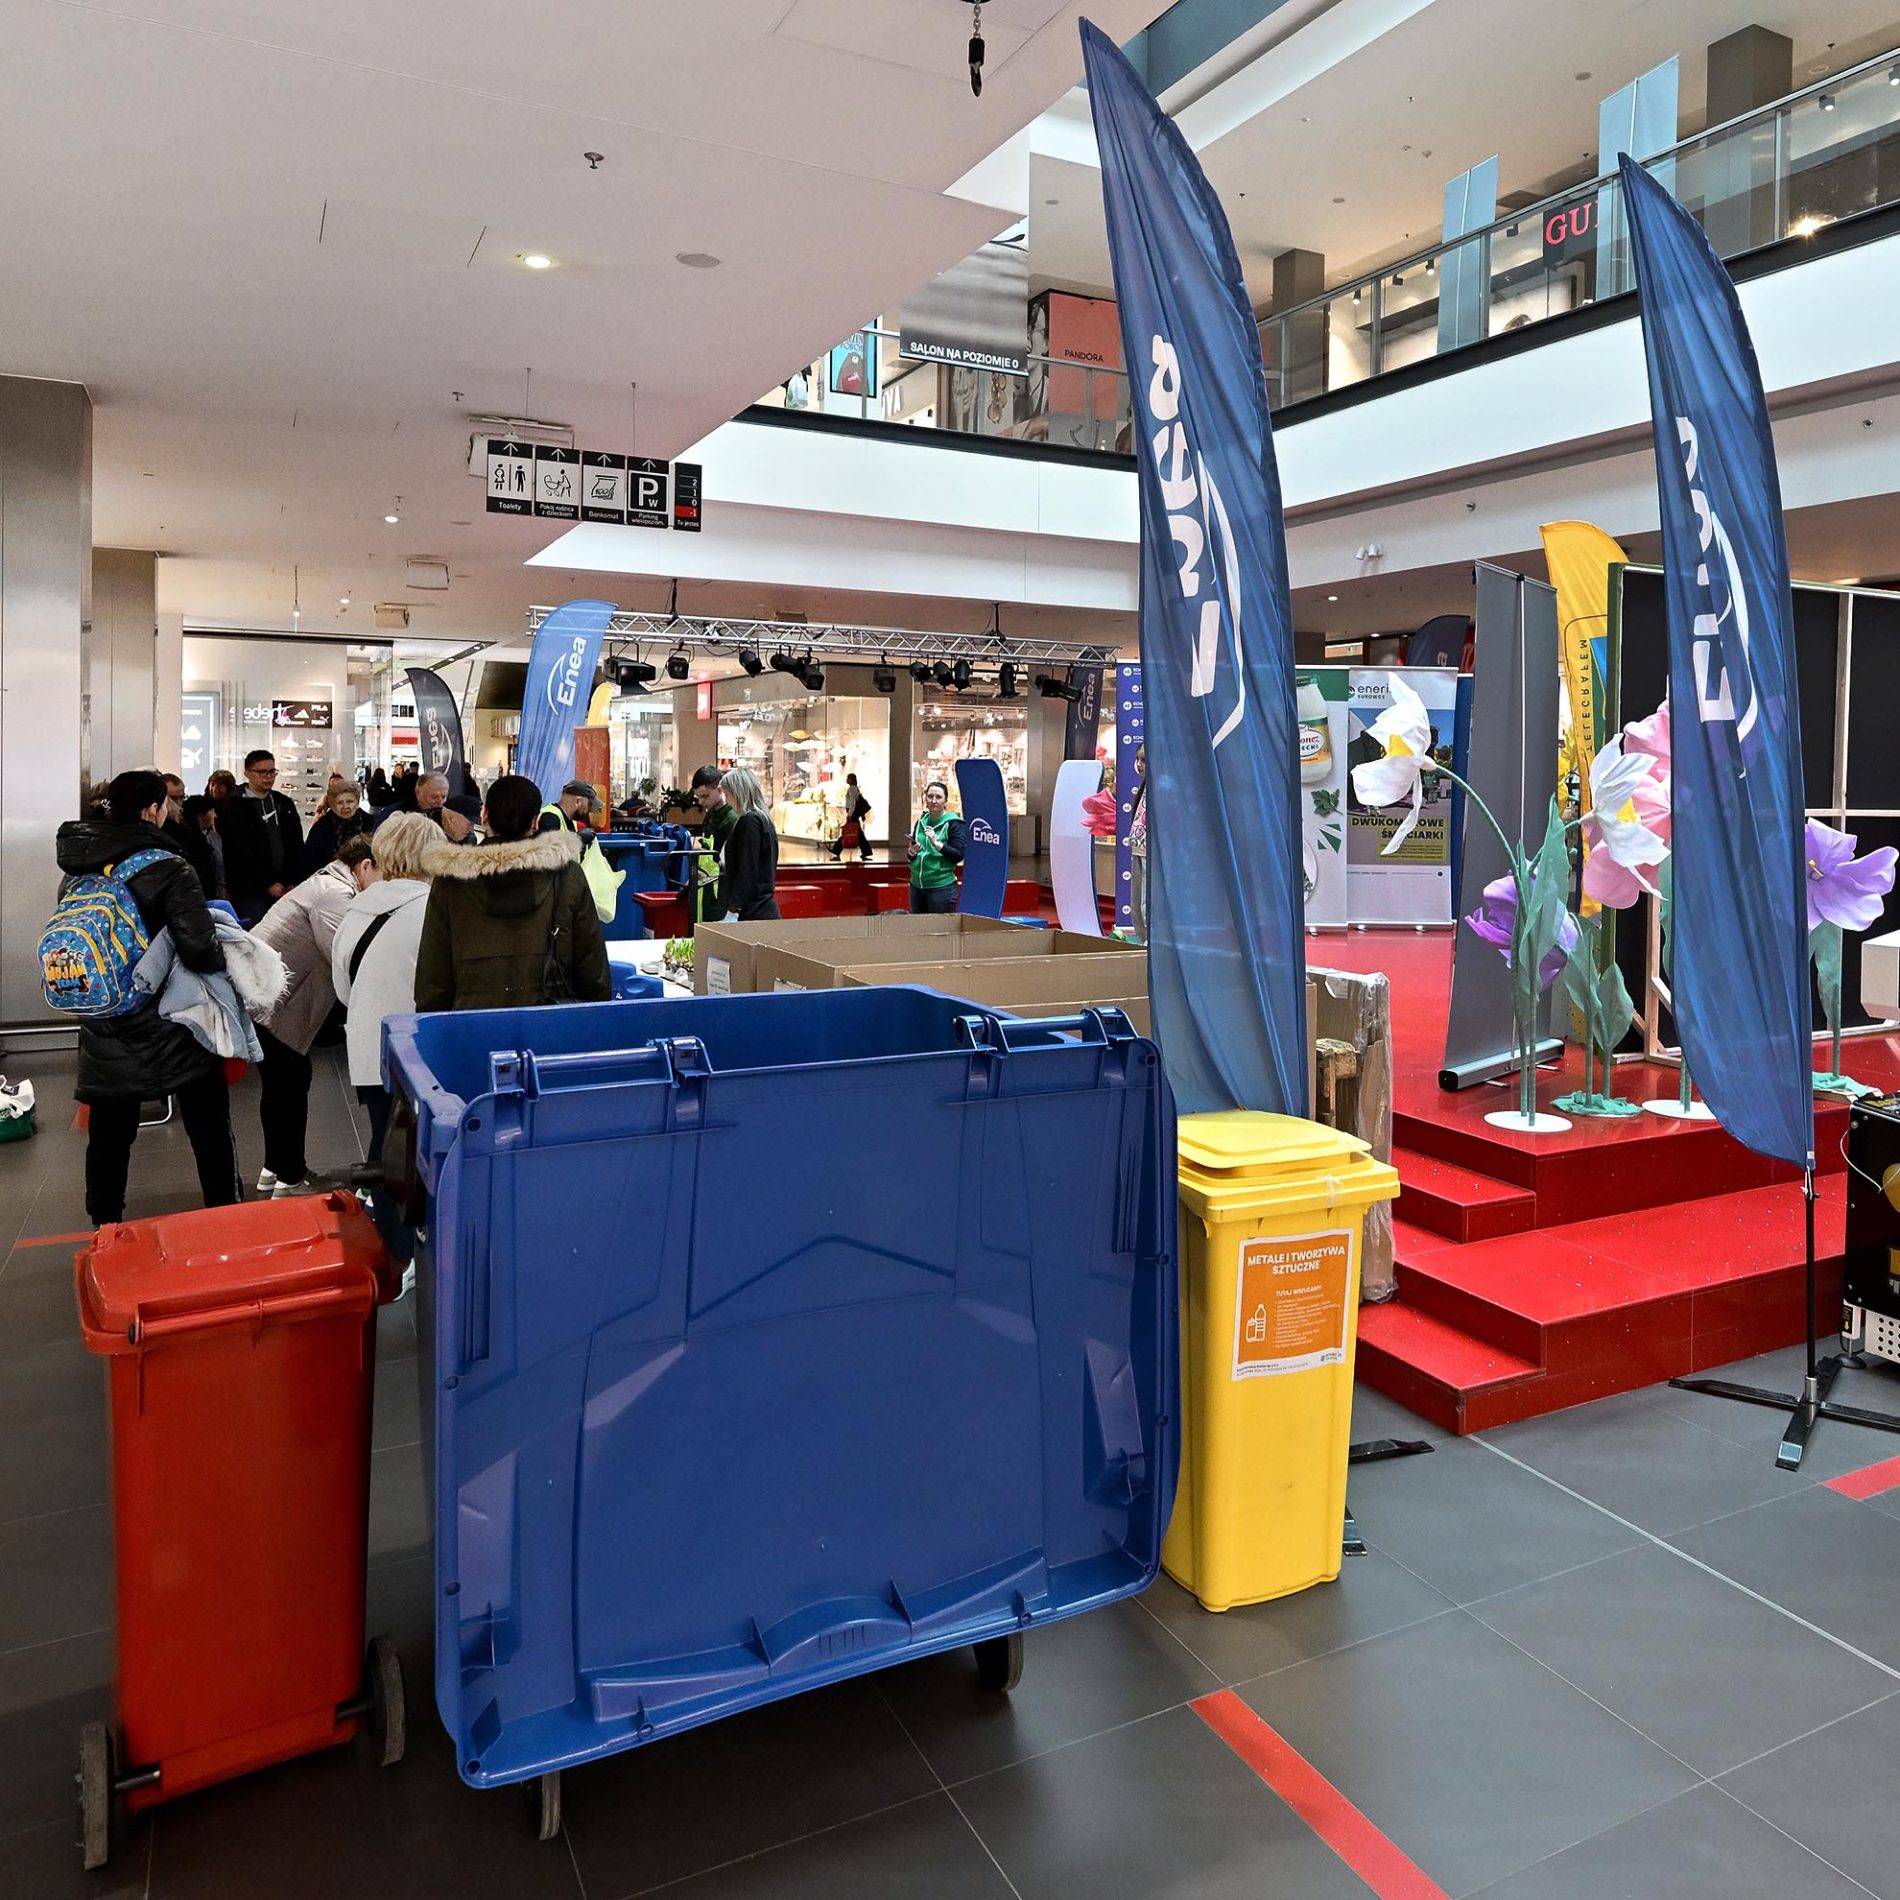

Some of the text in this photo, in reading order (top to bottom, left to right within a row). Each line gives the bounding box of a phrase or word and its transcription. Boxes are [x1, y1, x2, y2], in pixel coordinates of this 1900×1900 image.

[1545, 200, 1599, 245] GU
[910, 341, 1019, 369] SALON NA POZIOMIE 0
[1064, 349, 1104, 362] PANDORA
[692, 479, 698, 487] 2
[638, 477, 659, 507] P
[498, 502, 522, 511] Toalety
[588, 511, 619, 520] Bankomat
[557, 636, 587, 706] Enea
[1357, 683, 1392, 694] eneri
[1083, 673, 1095, 720] Enea
[1351, 817, 1444, 828] DWUKOMOWE
[973, 826, 1000, 845] Enea
[1381, 828, 1444, 840] ŚMCIARKI
[1247, 1253, 1285, 1267] METALE
[1291, 1245, 1346, 1261] TWORZYWA
[1272, 1260, 1321, 1275] SZTUCZNE
